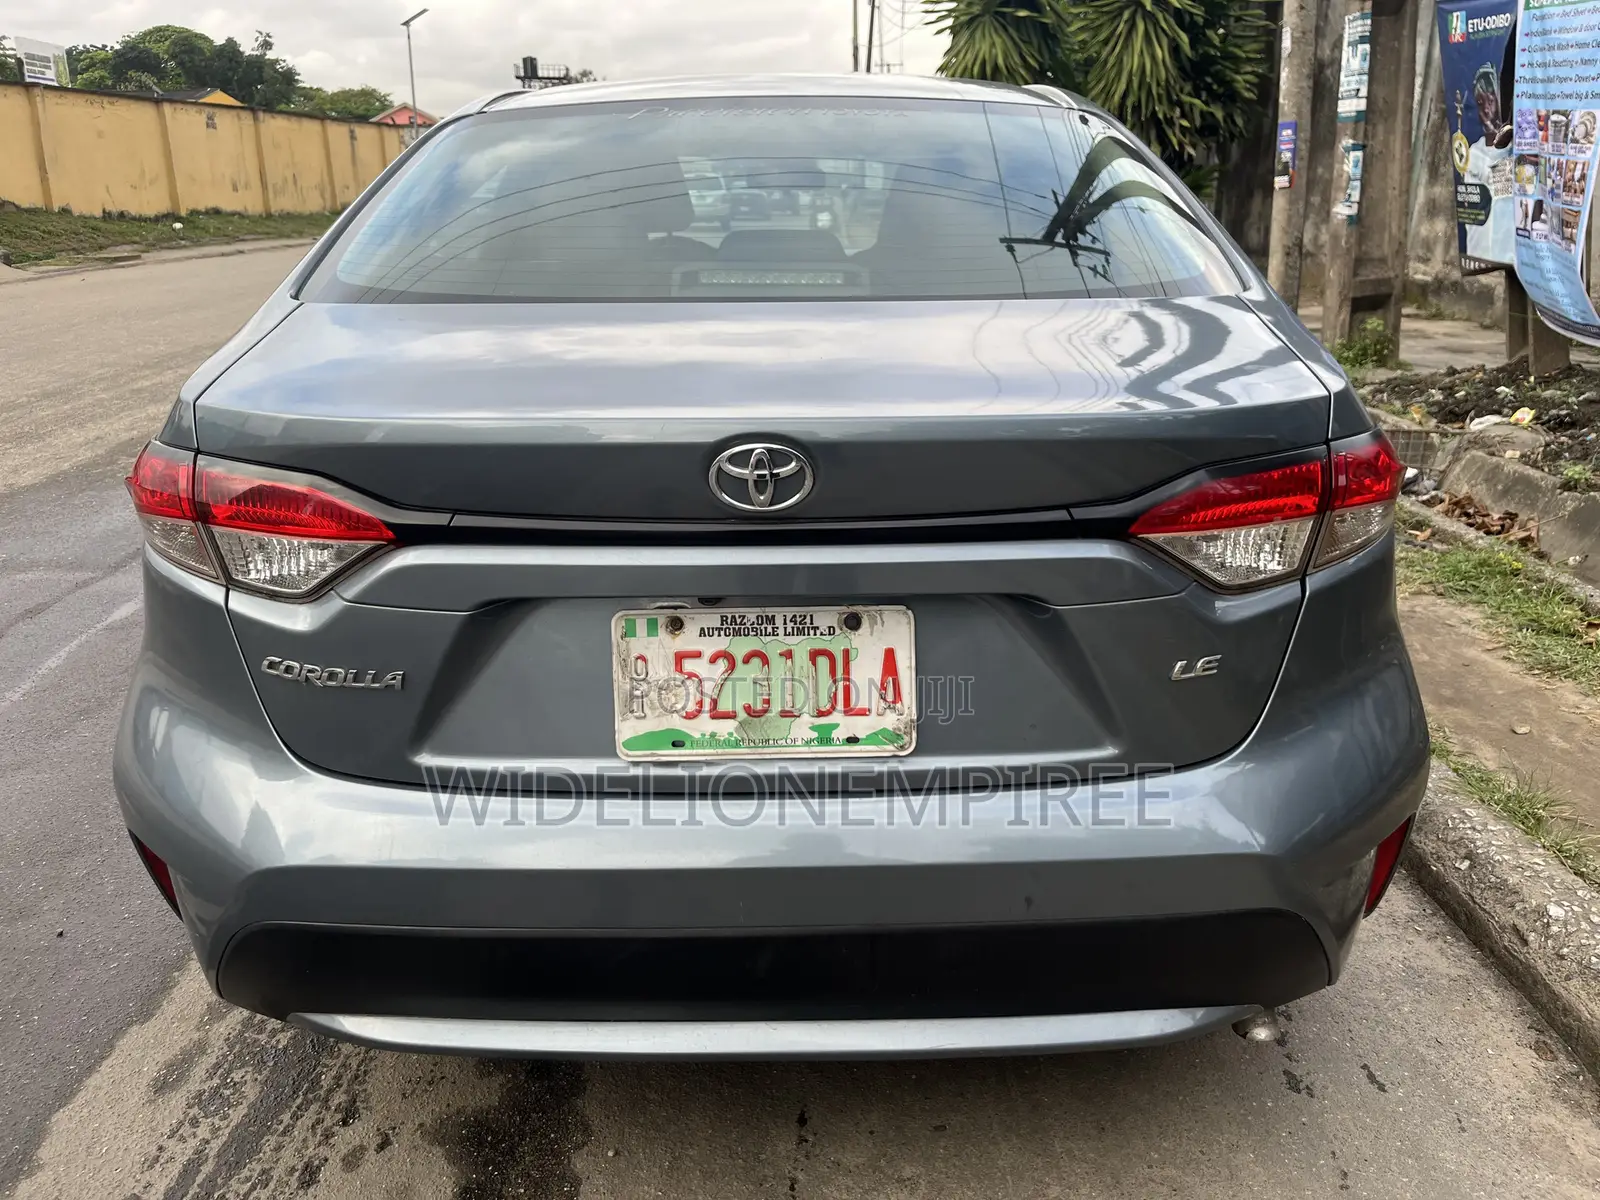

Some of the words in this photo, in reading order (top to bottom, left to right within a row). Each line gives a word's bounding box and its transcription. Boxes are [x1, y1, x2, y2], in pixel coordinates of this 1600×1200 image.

[720, 614, 776, 627] RAZOM
[783, 614, 814, 626] 1421
[699, 626, 779, 638] AUTOMOBILE
[261, 656, 405, 690] COROLLA
[1171, 654, 1222, 681] LE
[690, 738, 738, 748] FEDERAL
[738, 737, 784, 747] REPUBLIC
[785, 737, 798, 745] OF
[801, 736, 842, 745] NIGERIA
